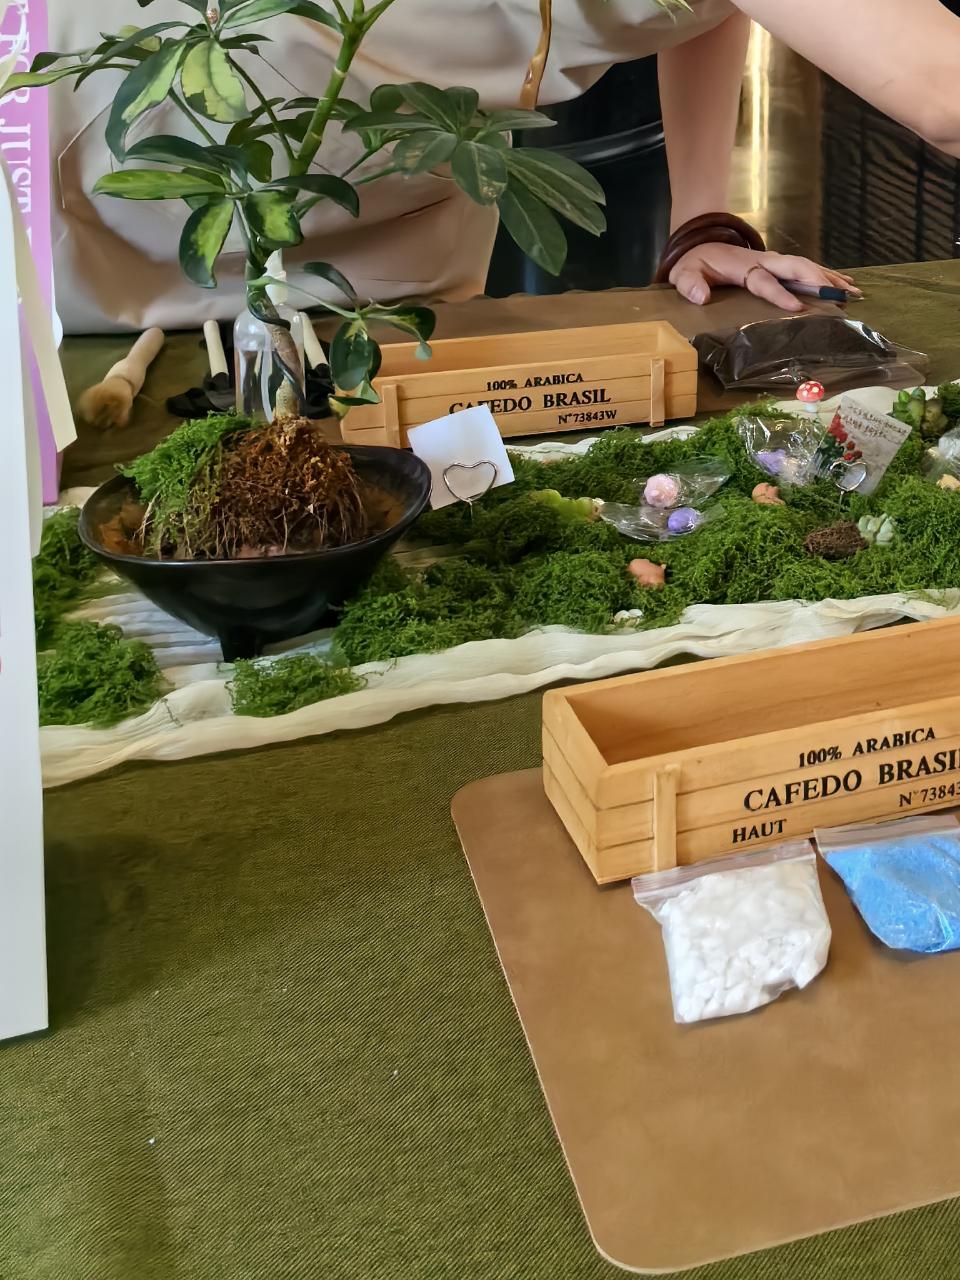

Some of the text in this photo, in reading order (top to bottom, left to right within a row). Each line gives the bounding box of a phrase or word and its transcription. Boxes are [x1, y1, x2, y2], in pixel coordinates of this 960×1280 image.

[486, 373, 584, 391] 100% ARABICA
[449, 388, 612, 415] CEDO BRASIL
[799, 726, 936, 769] 100% ARABICA
[743, 769, 862, 812] CAFEDO
[731, 818, 788, 844] HAUT
